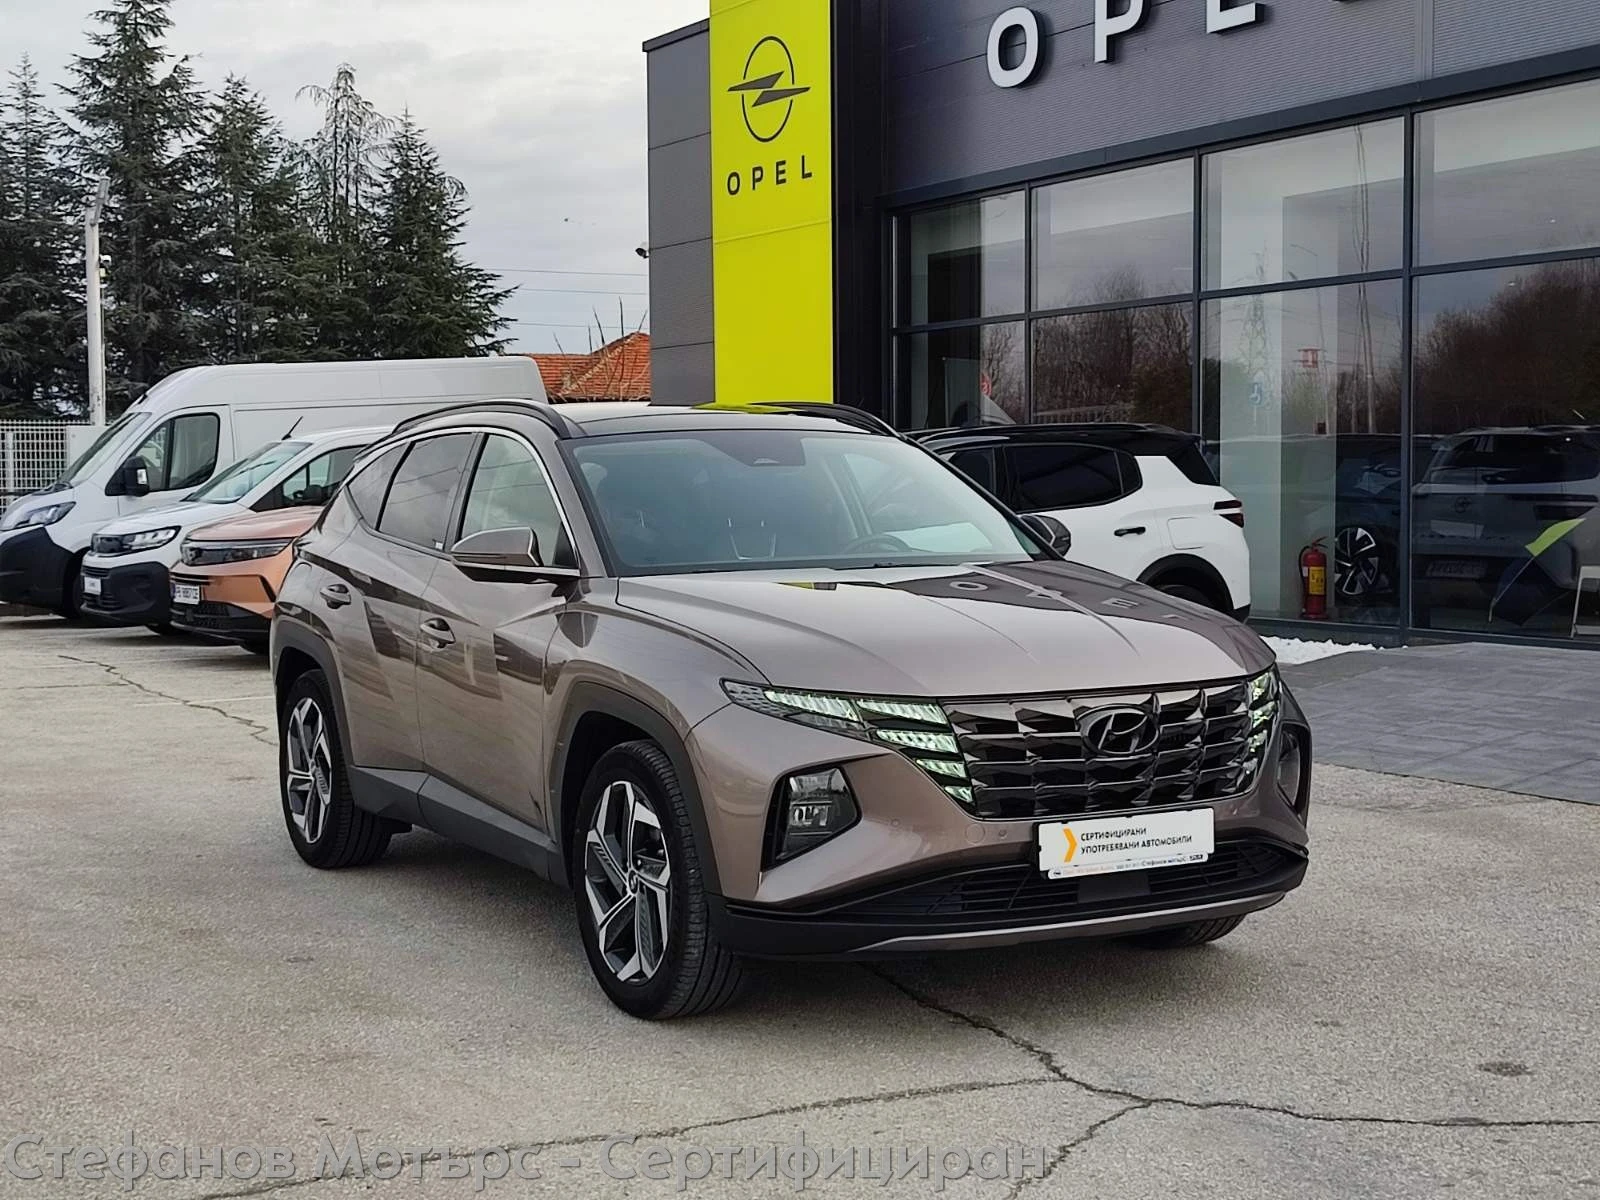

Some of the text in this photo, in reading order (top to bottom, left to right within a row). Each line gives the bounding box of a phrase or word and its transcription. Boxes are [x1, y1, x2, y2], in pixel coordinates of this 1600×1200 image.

[727, 155, 812, 195] OPEL
[1080, 828, 1147, 842] СЕРТИФИЦИРАНИ
[1141, 835, 1192, 848] АВТОМОБИЛИ
